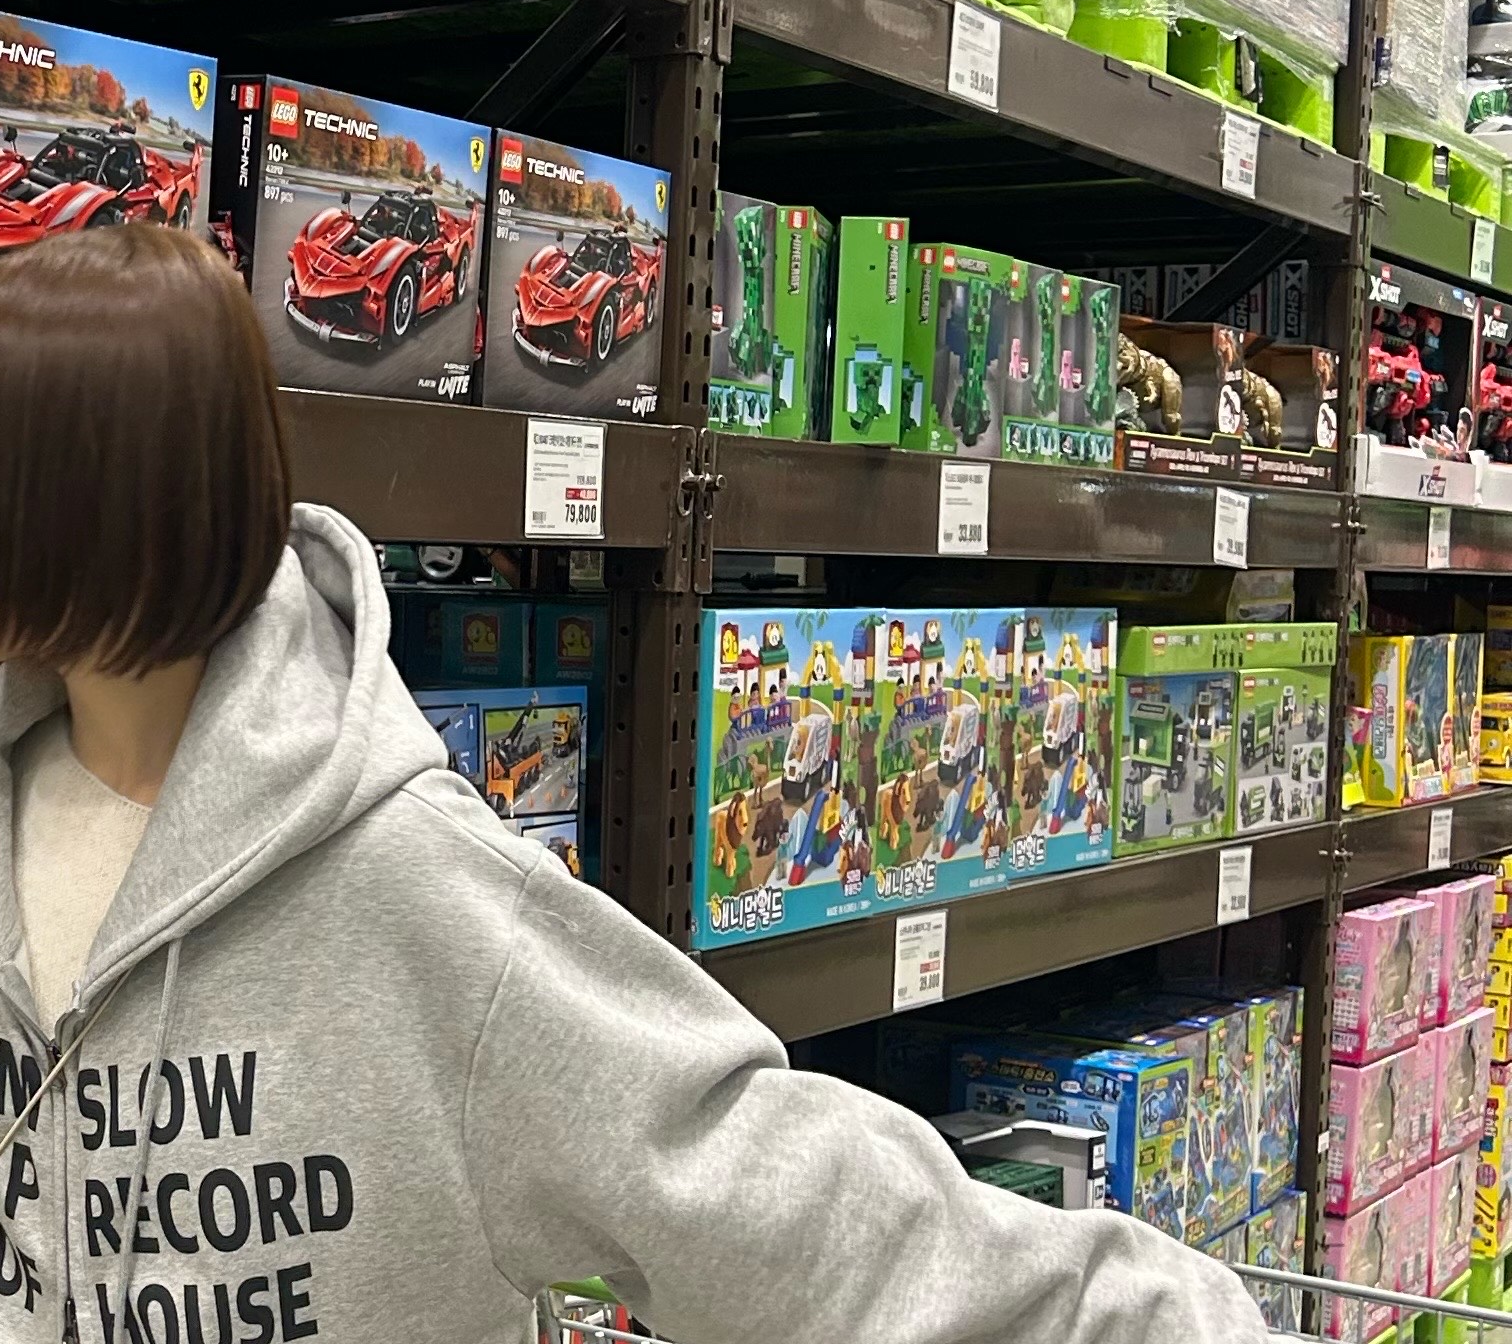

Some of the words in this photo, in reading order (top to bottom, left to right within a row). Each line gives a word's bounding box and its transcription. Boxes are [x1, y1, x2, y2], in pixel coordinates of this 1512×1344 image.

[271, 102, 298, 125] LEGO
[304, 110, 378, 140] TECHNIC
[239, 115, 253, 188] TECHNIC
[267, 144, 289, 162] 10+
[526, 157, 584, 185] TECHNIC
[498, 188, 516, 205] 10+
[565, 504, 597, 525] 79,800
[77, 1050, 257, 1151] SLOW
[85, 1154, 354, 1257] RECORD
